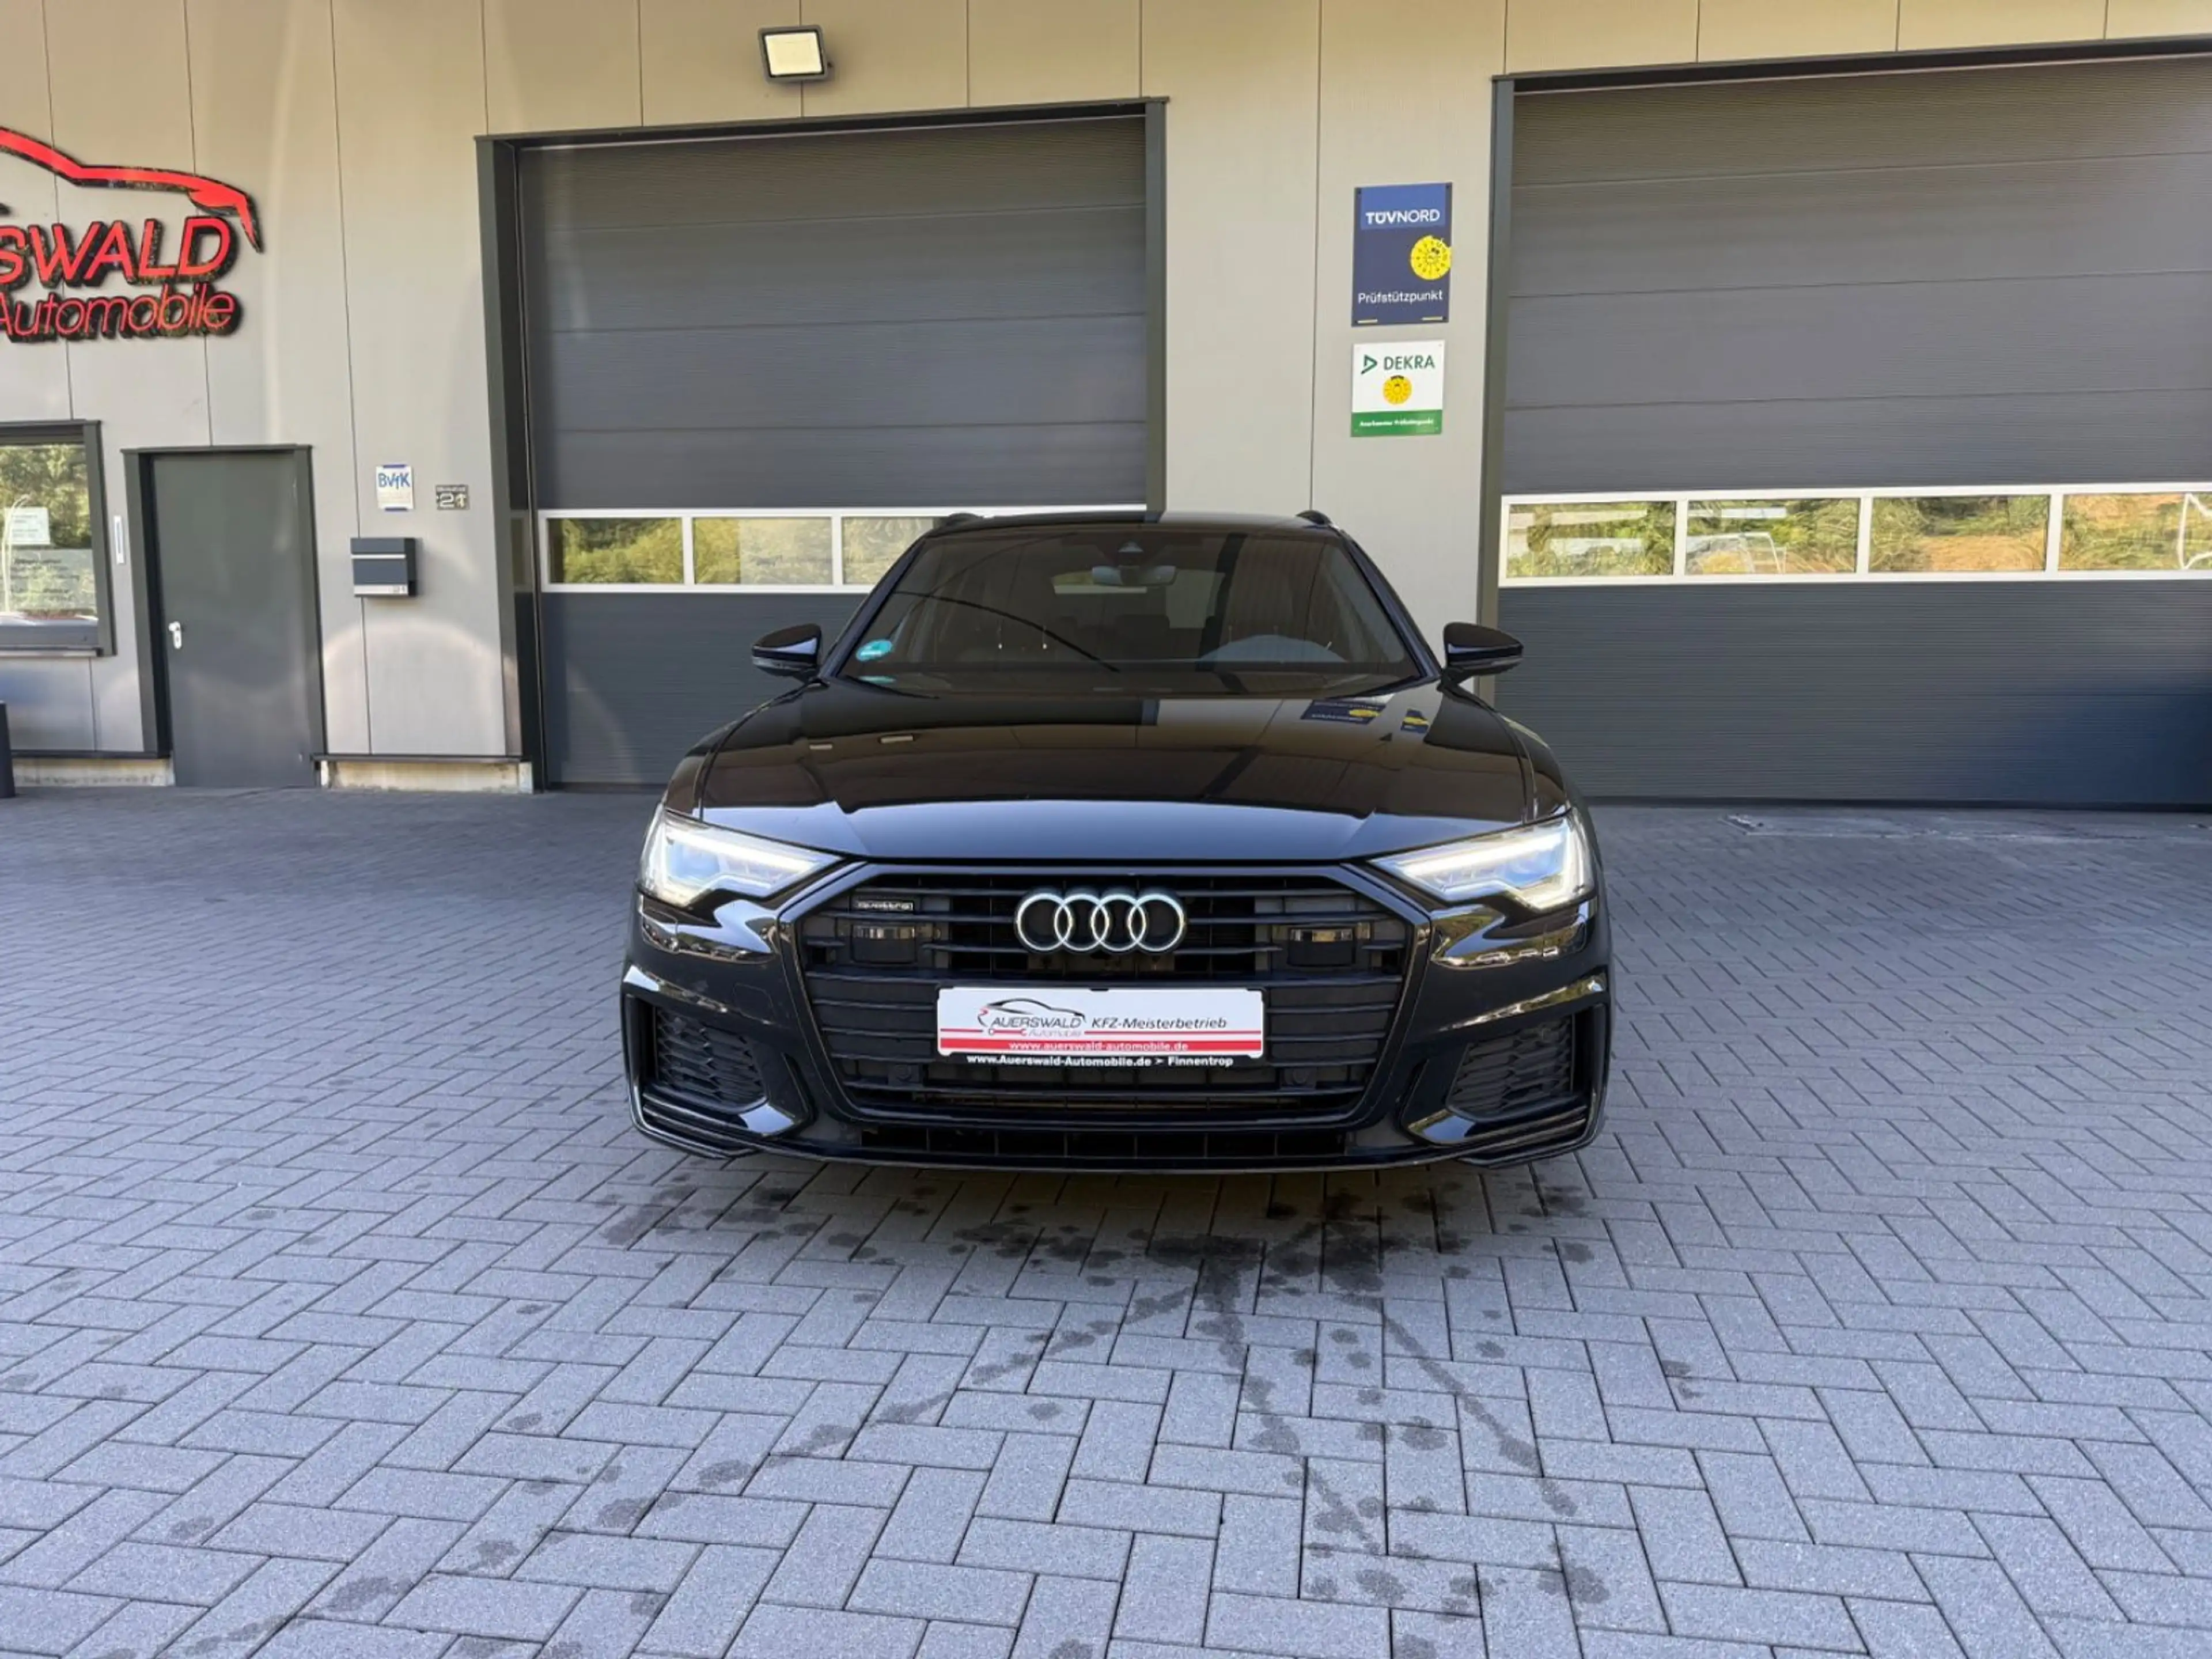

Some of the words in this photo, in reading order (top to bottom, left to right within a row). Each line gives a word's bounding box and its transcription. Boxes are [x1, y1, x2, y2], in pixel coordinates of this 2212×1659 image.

[1358, 290, 1443, 305] Prüfstützpunkt
[1384, 354, 1435, 371] DEKRA
[991, 1017, 1082, 1029] AUERSWALD
[1092, 1017, 1228, 1029] KFZ-Meisterbetrieb
[1009, 1040, 1190, 1052] www.auerswald-automobile.de
[967, 1054, 1152, 1067] www.Auerswald-Automobile.de
[1168, 1056, 1233, 1067] Finnentrop
